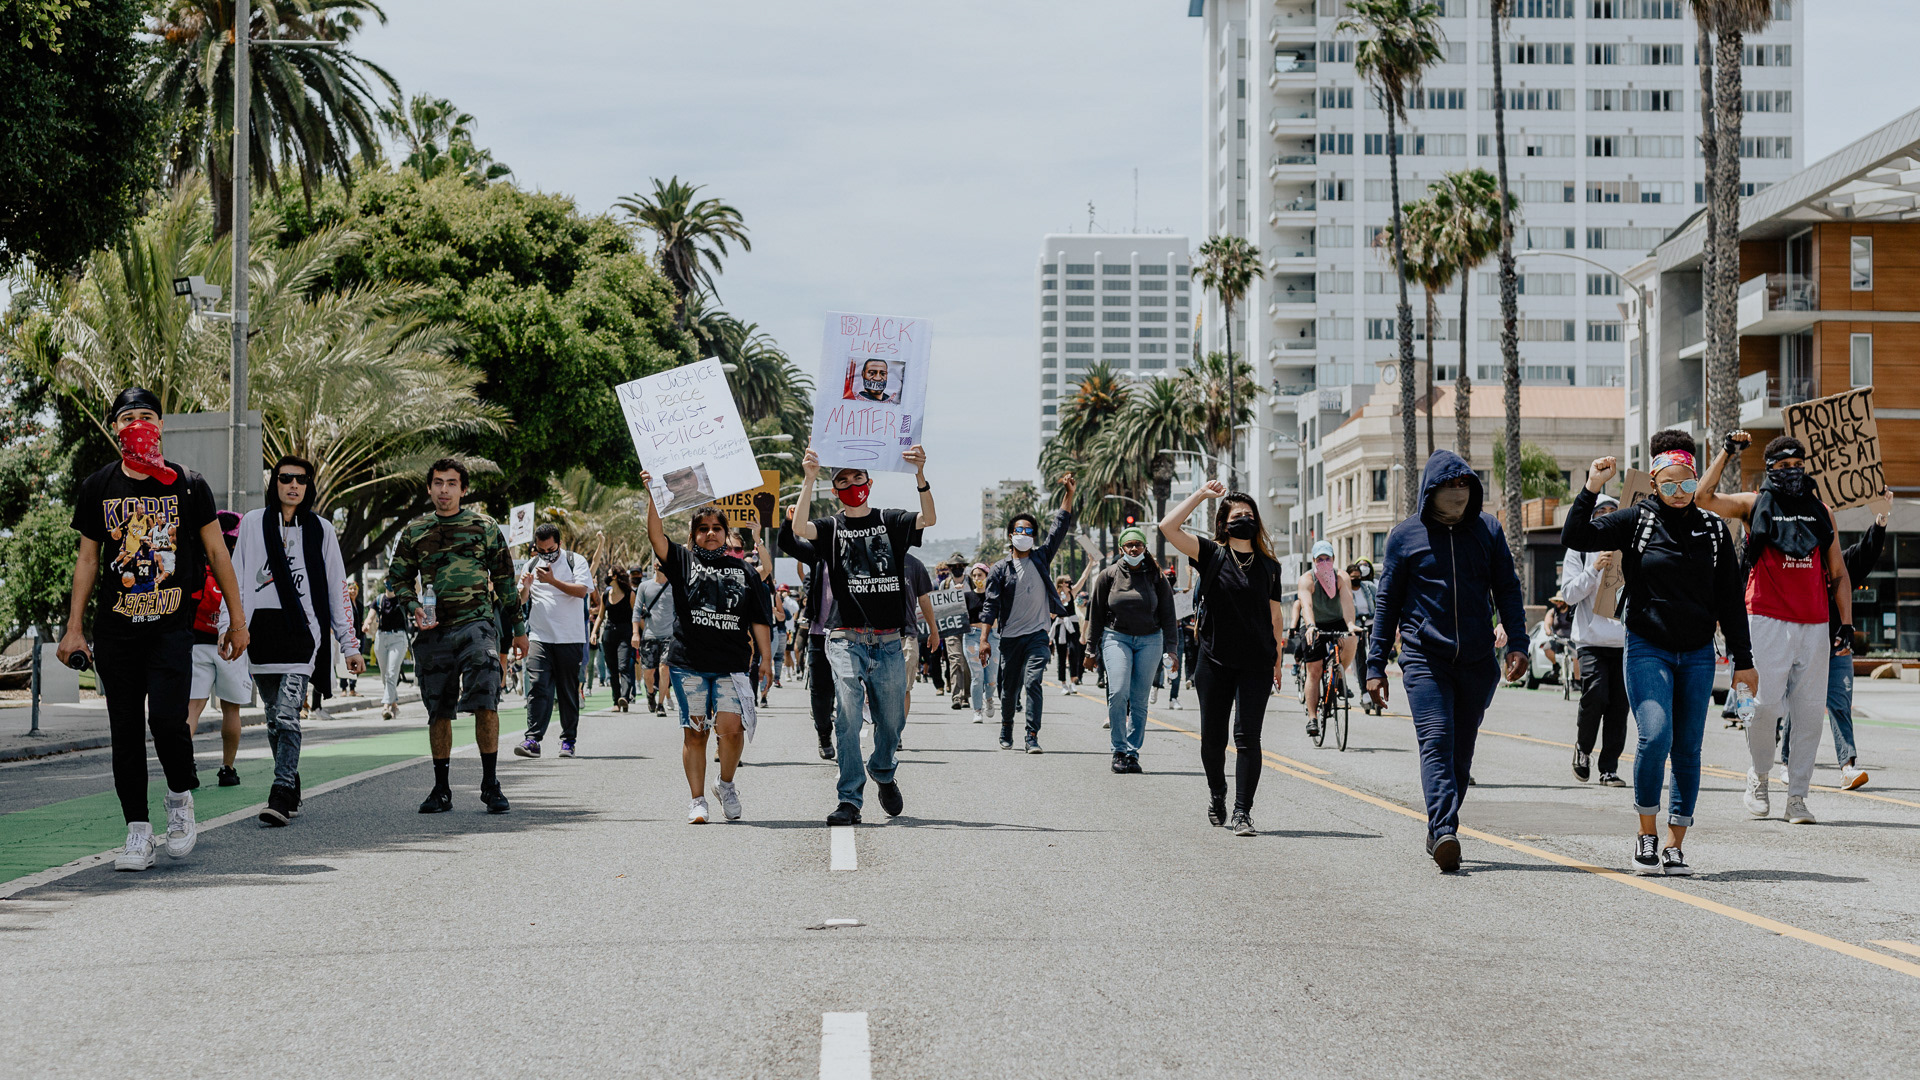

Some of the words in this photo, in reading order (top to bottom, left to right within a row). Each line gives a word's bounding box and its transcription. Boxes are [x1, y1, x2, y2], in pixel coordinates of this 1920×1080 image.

[840, 315, 915, 342] BLACK
[850, 337, 899, 354] LIVES
[619, 382, 643, 403] NO
[629, 400, 650, 418] NO
[1788, 388, 1873, 438] PROTECT
[1808, 422, 1869, 457] BLACK
[1804, 447, 1852, 476] IVES
[1857, 436, 1877, 465] AT
[1815, 475, 1847, 509] LL
[1838, 461, 1886, 503] COSTS
[836, 528, 870, 538] NOBODY
[138, 566, 149, 576] 24
[723, 567, 745, 575] DIED
[870, 584, 877, 593] A
[878, 582, 900, 593] KNEE
[112, 587, 182, 617] LEGEND
